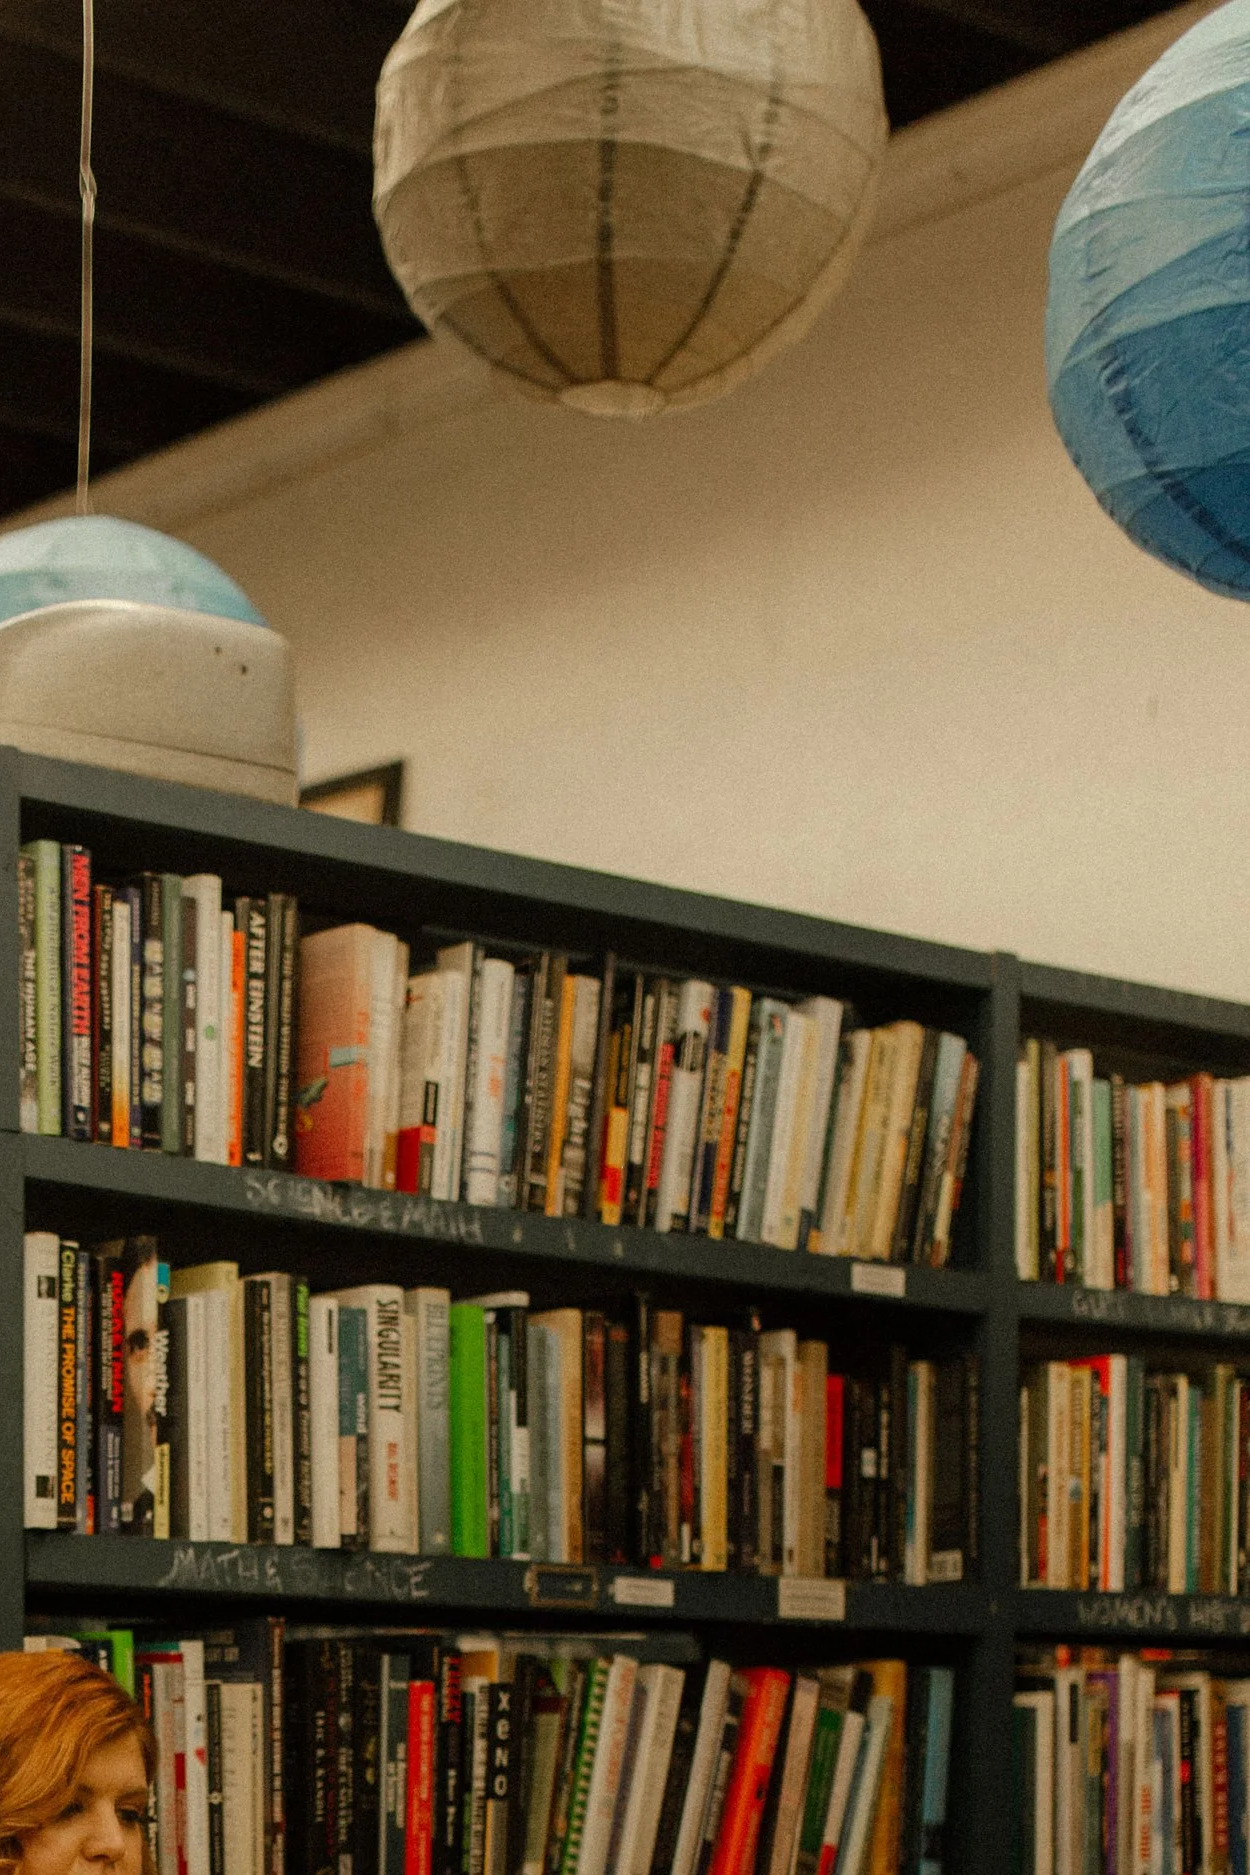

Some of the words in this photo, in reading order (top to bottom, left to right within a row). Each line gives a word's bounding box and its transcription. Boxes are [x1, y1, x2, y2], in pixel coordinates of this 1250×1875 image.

[72, 854, 91, 901] MEN
[72, 904, 91, 964] FROM
[249, 911, 266, 974] AFTER
[24, 950, 36, 979] THE
[24, 982, 36, 1038] HUMAN
[72, 967, 91, 1035] EARTH
[246, 978, 265, 1069] EINSTEIN
[62, 1250, 76, 1303] Clarke
[61, 1306, 76, 1340] THE
[61, 1343, 76, 1420] PROMISE
[155, 1329, 170, 1417] Weather
[376, 1299, 403, 1414] SINGULARITY
[61, 1422, 76, 1446] OF
[61, 1449, 75, 1504] SPACE
